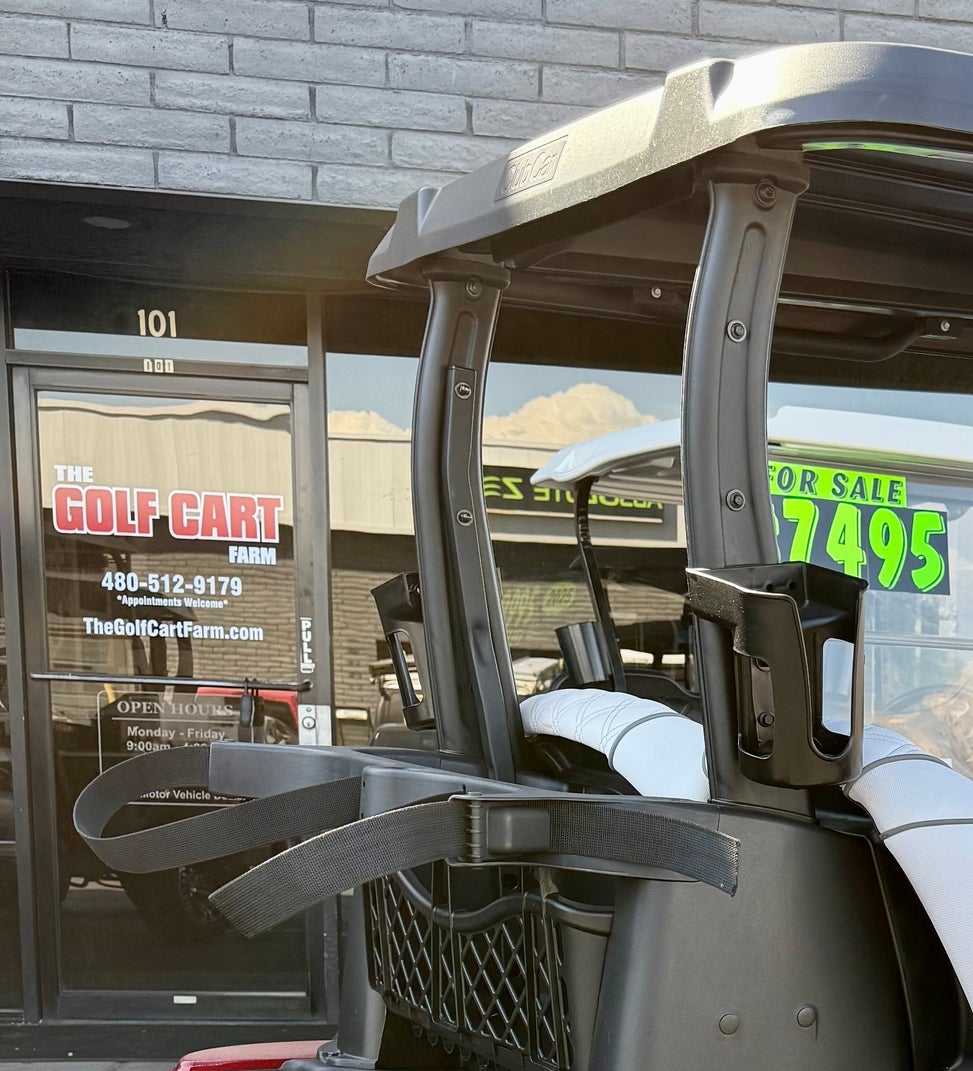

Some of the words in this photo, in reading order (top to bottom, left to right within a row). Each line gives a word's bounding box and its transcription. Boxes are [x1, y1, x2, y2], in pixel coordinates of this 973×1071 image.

[138, 309, 177, 338] 101
[144, 359, 174, 373] 101
[54, 465, 94, 483] THE
[831, 472, 904, 504] SALE
[53, 484, 160, 537] GOLF
[168, 489, 283, 543] CART
[229, 545, 277, 566] FARM
[772, 498, 946, 592] 7495
[101, 571, 243, 597] 480-512-9179
[83, 617, 264, 641] TheGolfCartFarm.com
[301, 620, 313, 664] PULL
[117, 701, 165, 715] OPEN
[170, 702, 234, 716] HOURS
[127, 726, 176, 738] Monday
[187, 728, 226, 741] Friday
[126, 740, 171, 751] 9:00am
[173, 789, 211, 800] Vehicle
